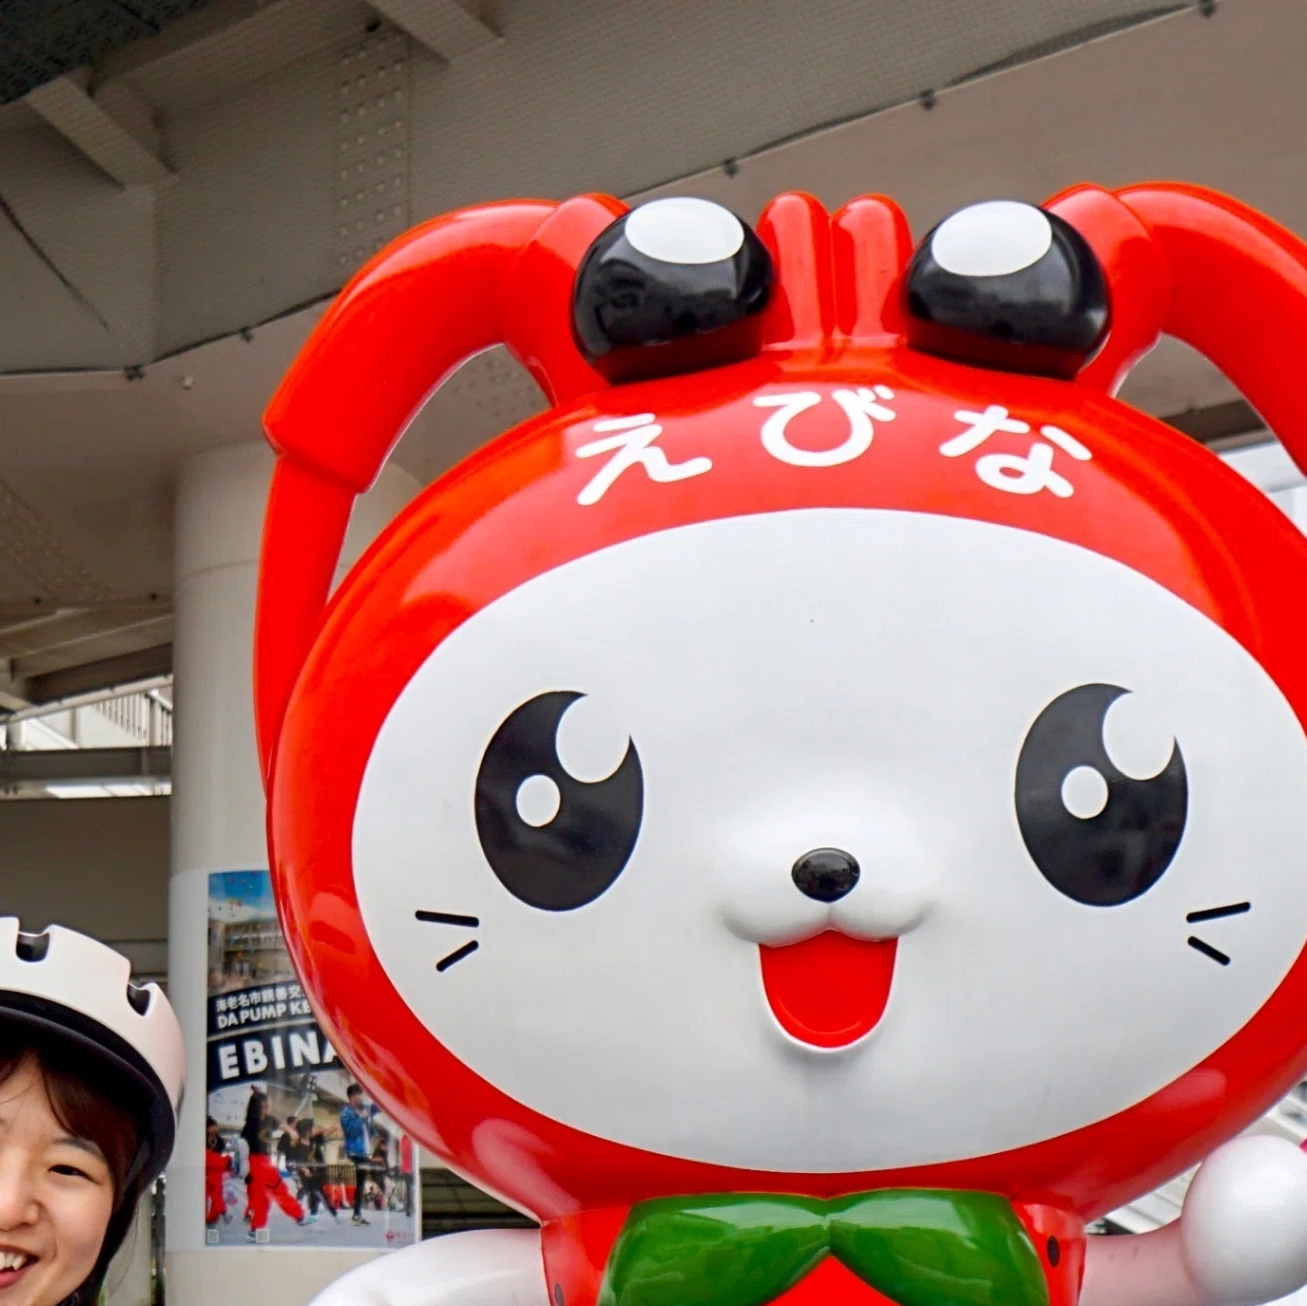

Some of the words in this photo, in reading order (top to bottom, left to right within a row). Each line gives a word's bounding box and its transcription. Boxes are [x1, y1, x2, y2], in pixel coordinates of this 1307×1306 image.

[576, 384, 1093, 507] えびな
[217, 1013, 239, 1029] DA
[240, 1002, 287, 1024] PUMP
